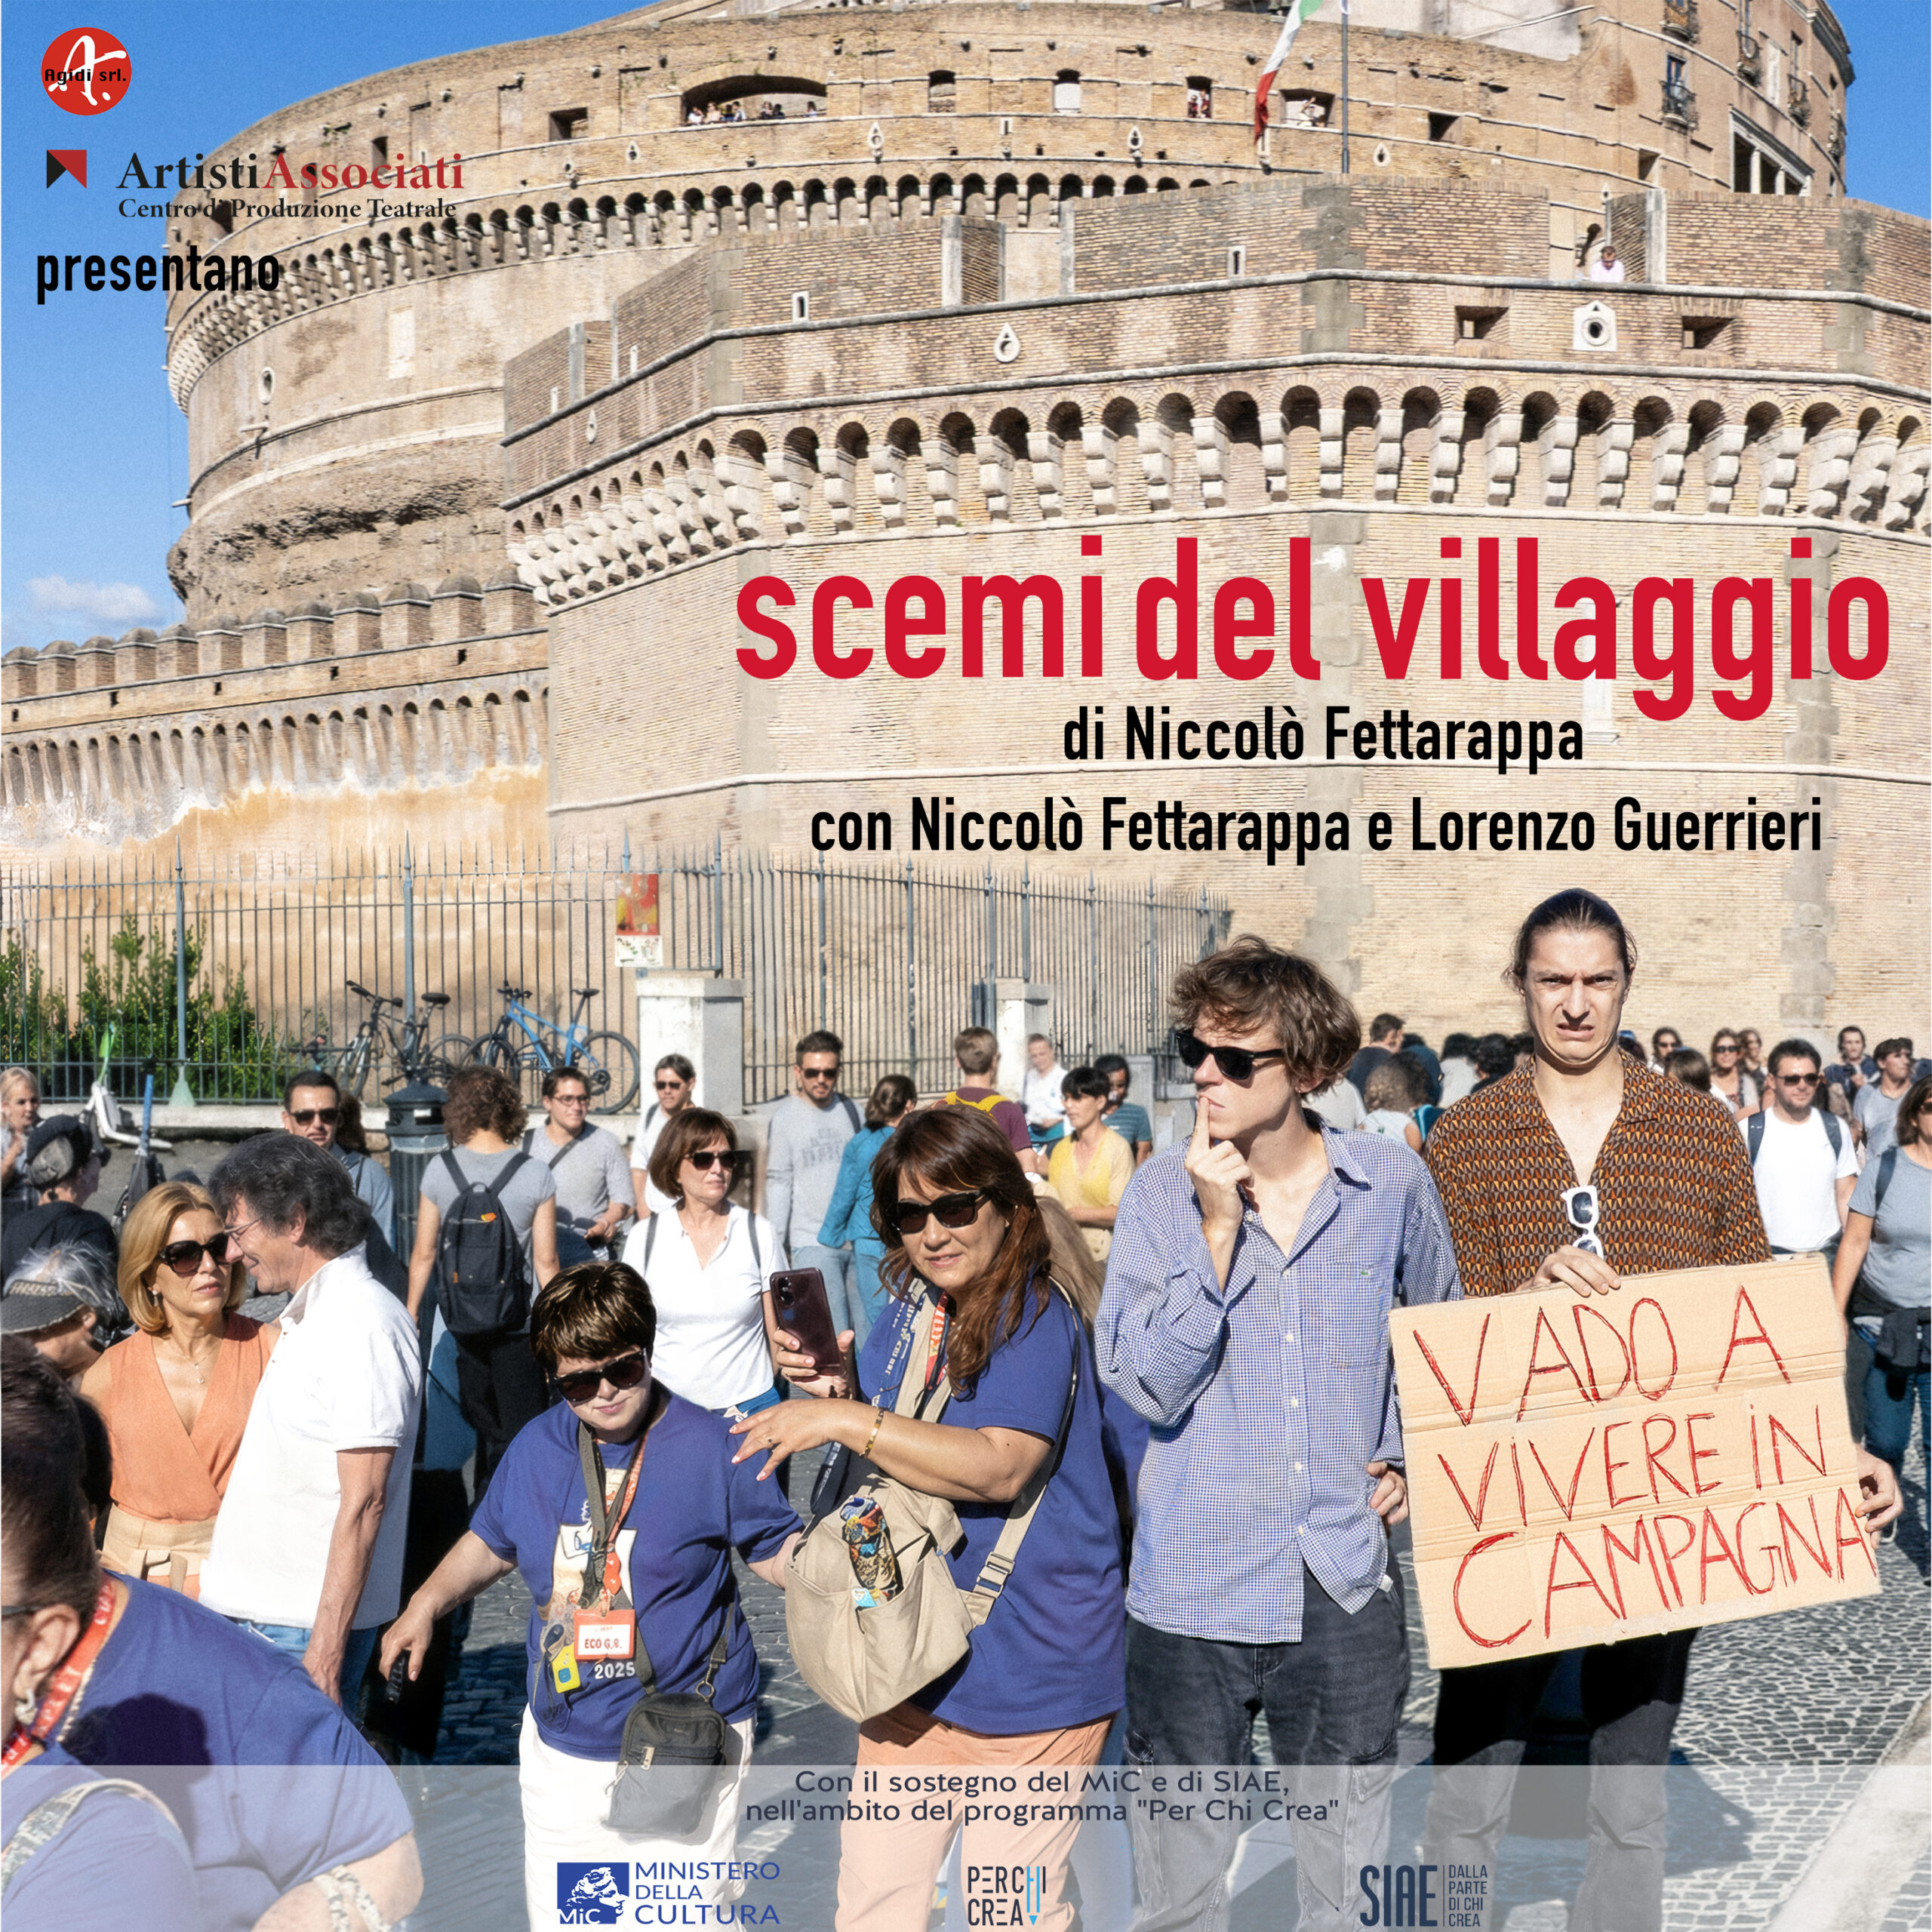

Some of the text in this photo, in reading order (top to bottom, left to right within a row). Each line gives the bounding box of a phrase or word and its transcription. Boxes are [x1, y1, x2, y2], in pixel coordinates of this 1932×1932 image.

[1413, 1285, 1792, 1427] VADO A
[1453, 1487, 1878, 1648] CAMPAGNA
[594, 1661, 635, 1679] 2025
